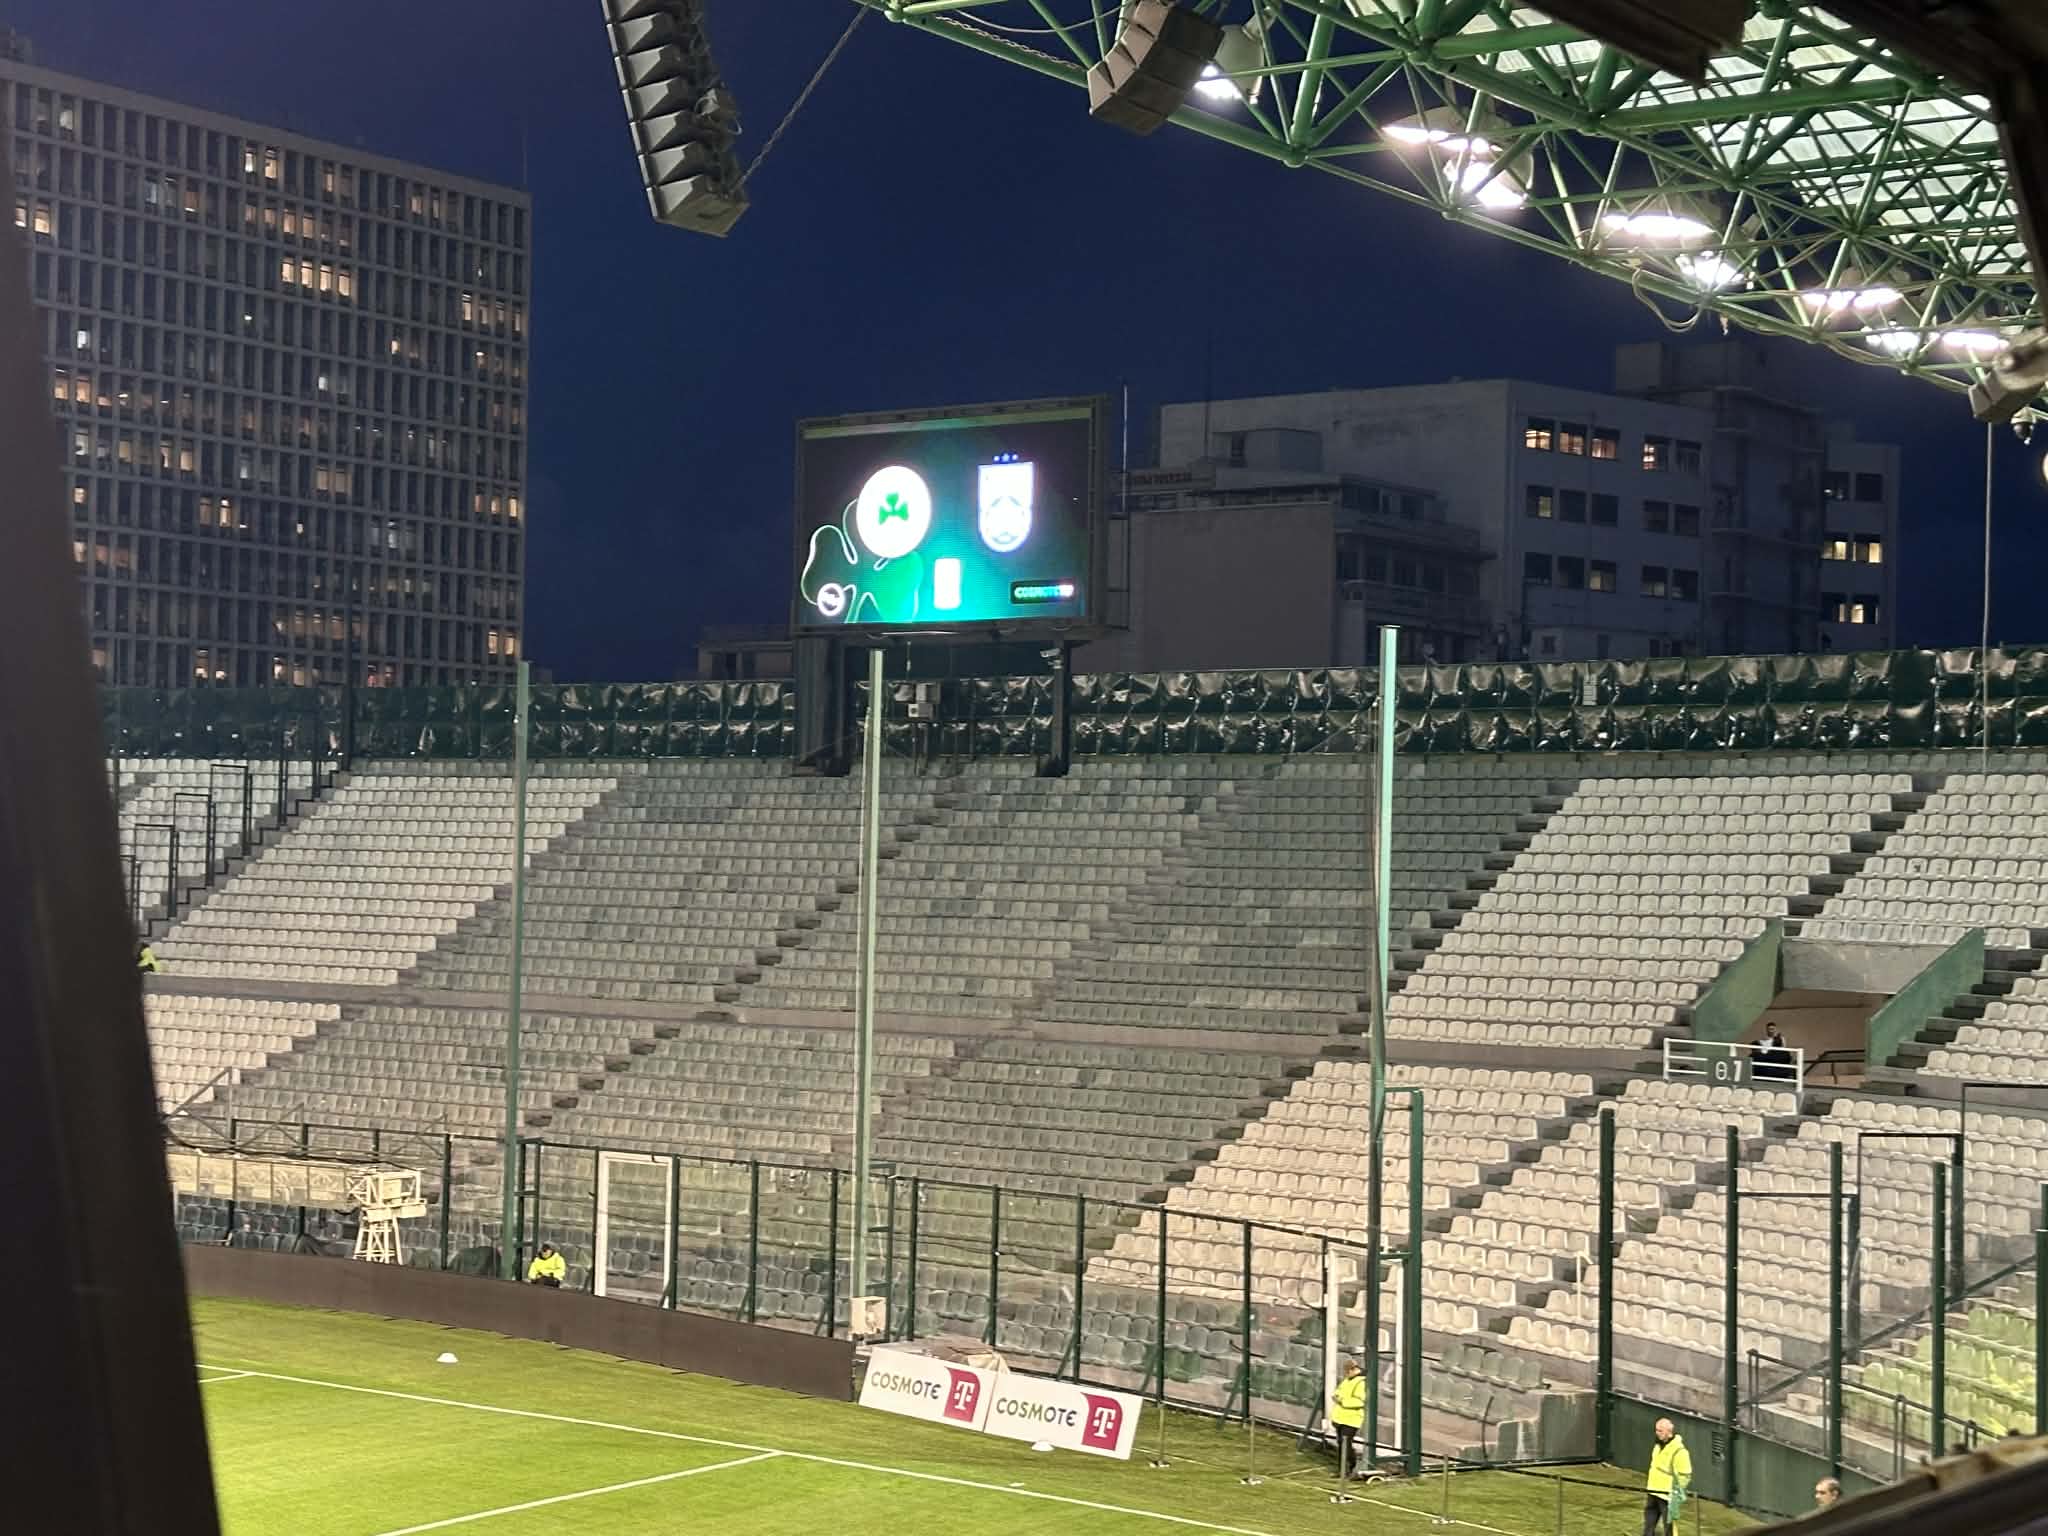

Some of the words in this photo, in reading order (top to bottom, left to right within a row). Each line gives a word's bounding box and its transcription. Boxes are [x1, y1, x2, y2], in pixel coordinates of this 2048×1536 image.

[870, 1371, 942, 1400] COSMOTE
[953, 1380, 976, 1411] T
[996, 1397, 1078, 1427] COSMOTE
[1092, 1406, 1117, 1438] T
